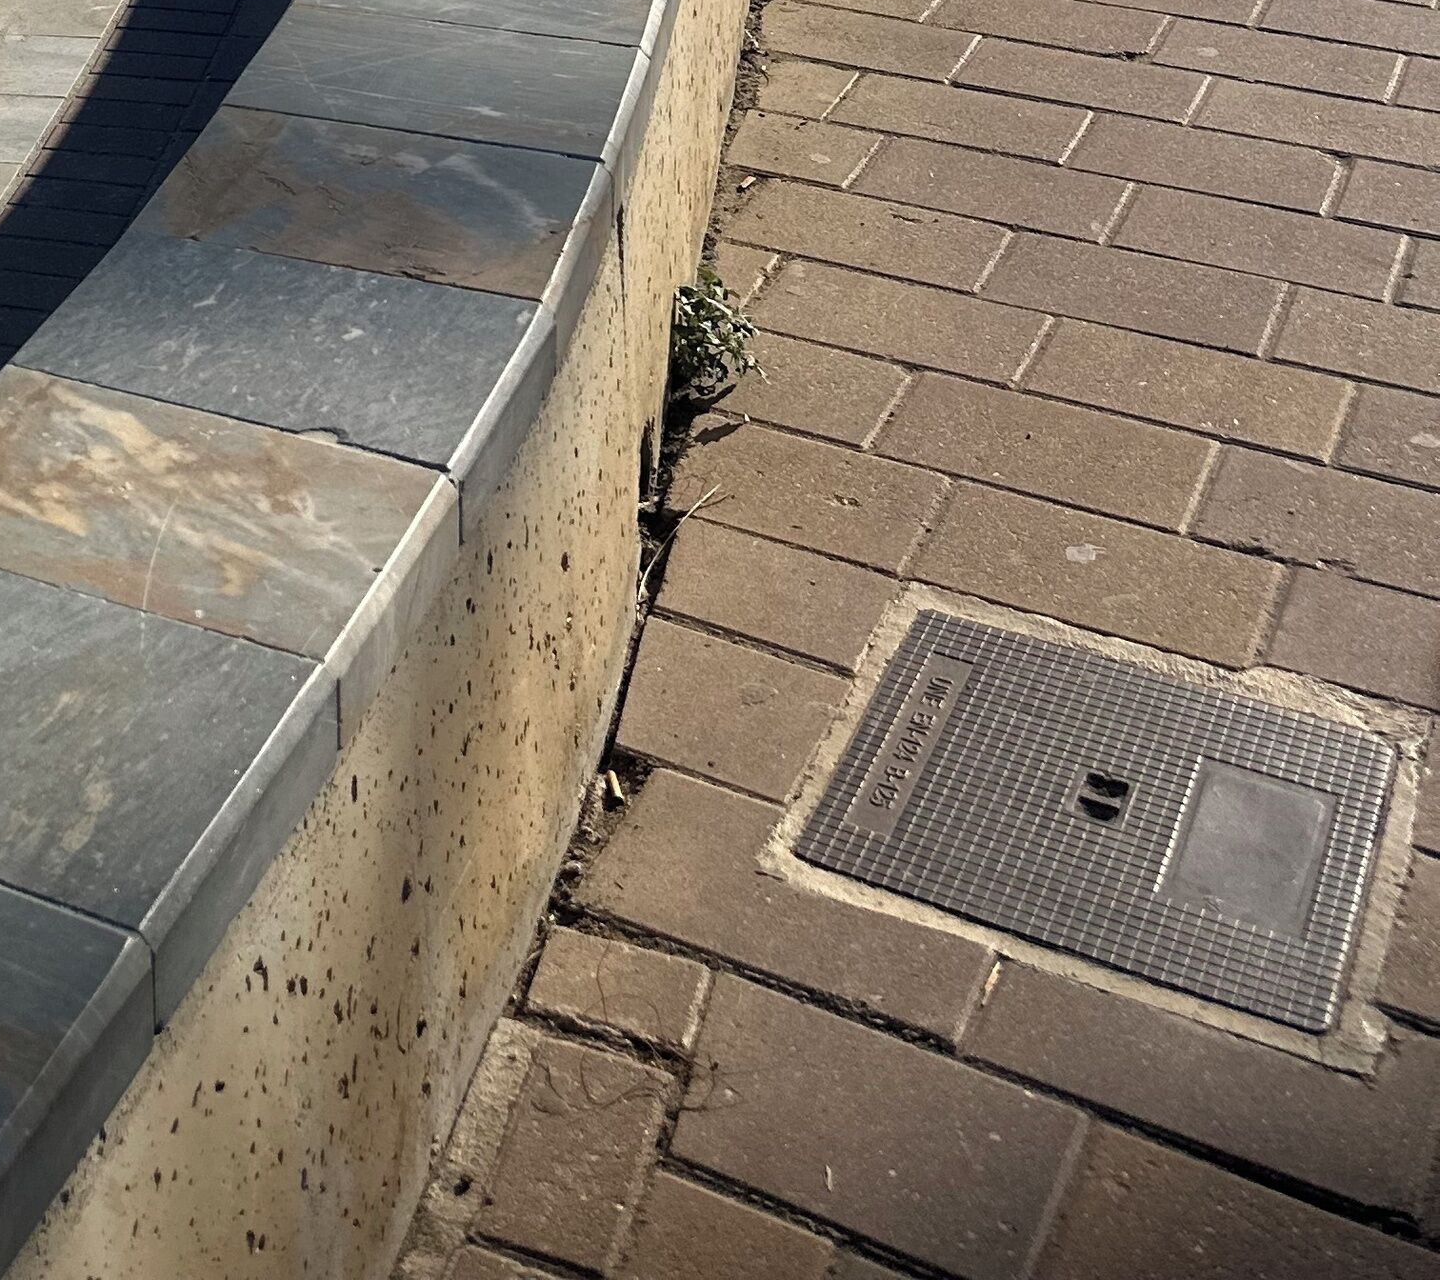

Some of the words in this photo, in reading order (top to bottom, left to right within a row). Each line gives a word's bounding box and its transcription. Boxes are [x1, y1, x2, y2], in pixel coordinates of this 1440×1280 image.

[921, 676, 955, 711] UNE
[892, 710, 938, 763] EN-124
[868, 765, 912, 811] B-125
